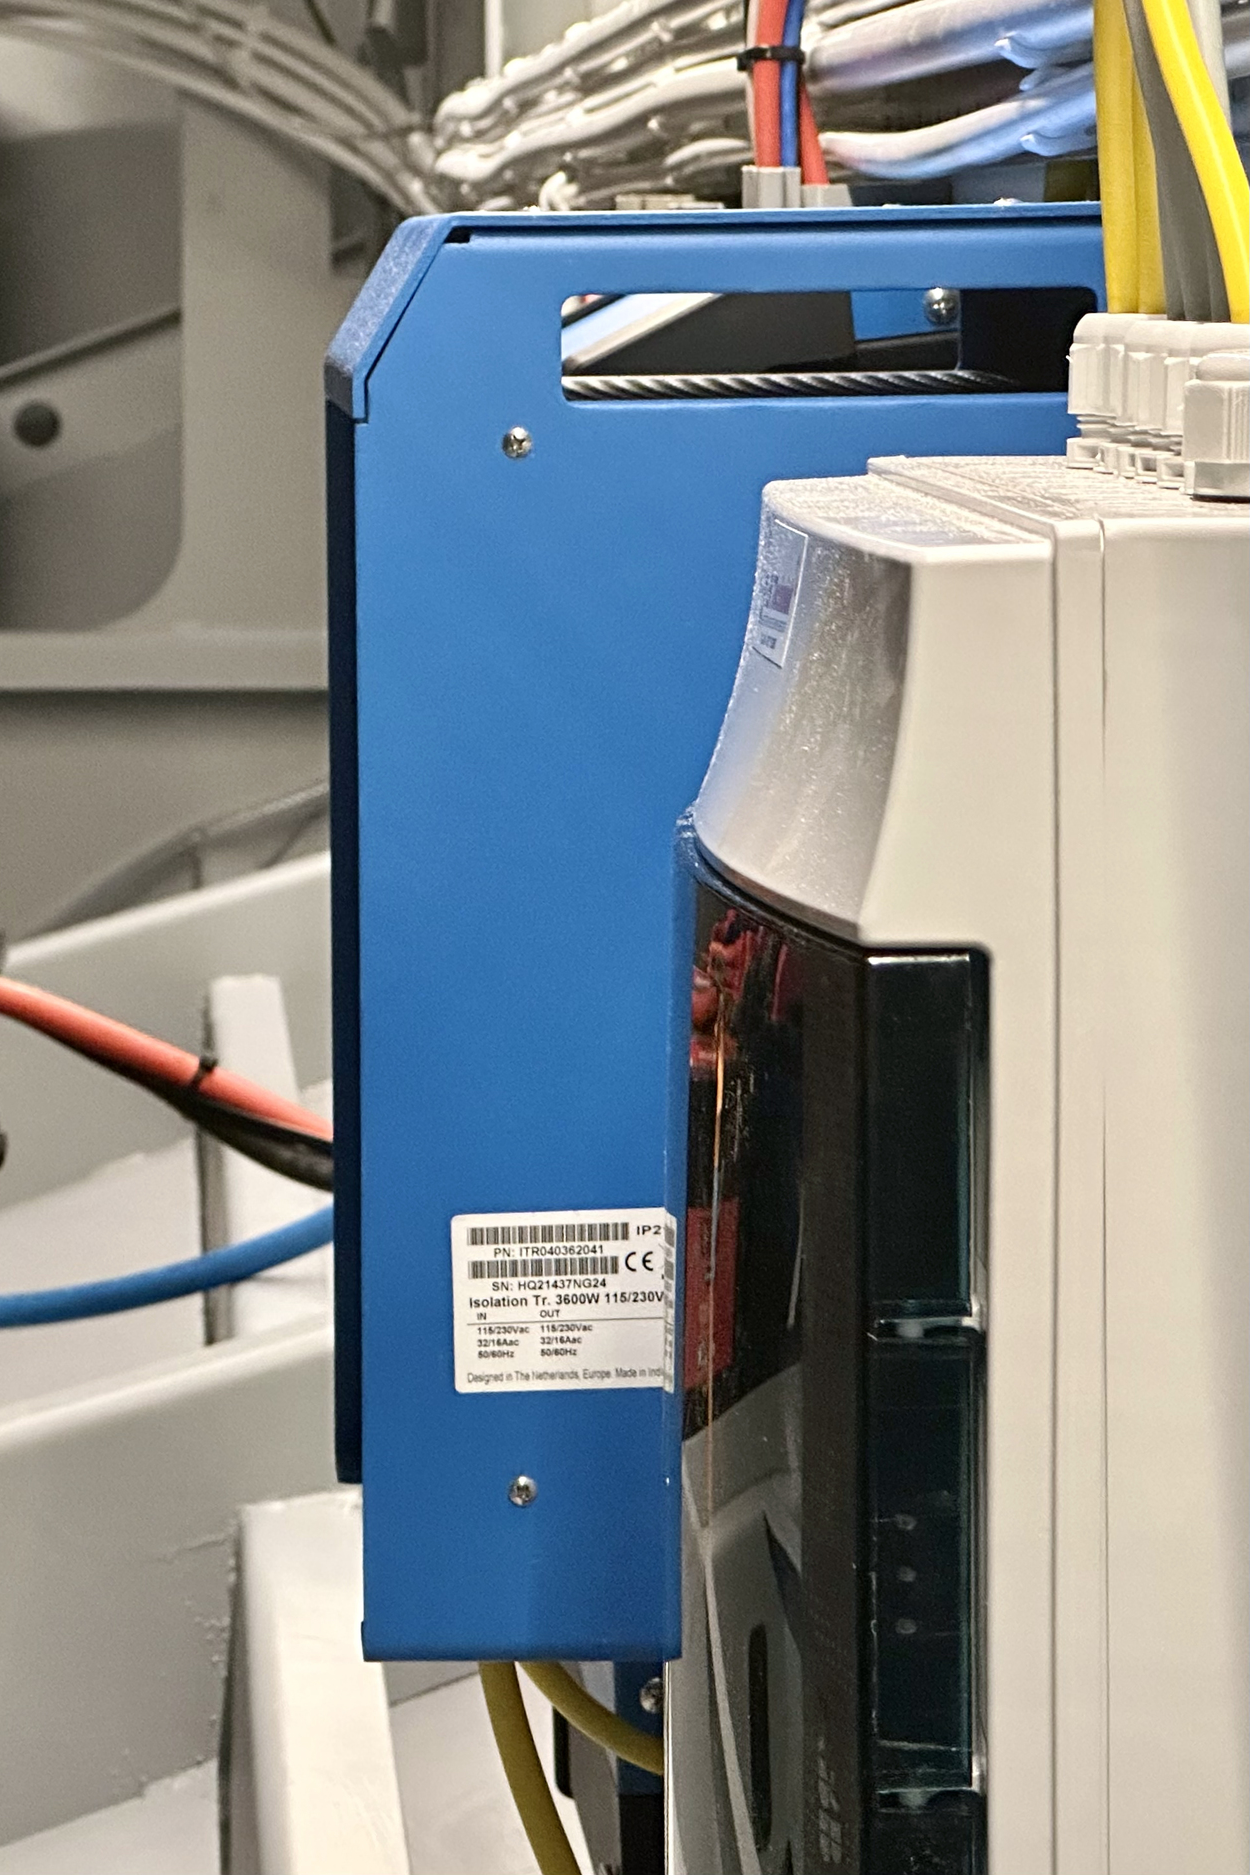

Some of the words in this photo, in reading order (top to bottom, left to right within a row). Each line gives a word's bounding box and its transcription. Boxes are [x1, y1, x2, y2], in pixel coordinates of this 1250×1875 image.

[636, 1224, 662, 1236] IP2
[493, 1247, 515, 1258] PN:
[519, 1245, 604, 1257] ITR040362041
[491, 1281, 513, 1292] SN:
[518, 1278, 607, 1291] HQ21437NG24
[469, 1296, 528, 1309] Isolation
[532, 1294, 551, 1306] Tr.
[555, 1292, 600, 1305] 3600W
[476, 1312, 487, 1321] IN
[539, 1309, 561, 1318] OUT
[477, 1325, 530, 1335] 115/230Vac
[540, 1323, 593, 1333] 115/230Vac
[467, 1372, 503, 1385] Designed
[514, 1370, 530, 1381] The
[615, 1367, 637, 1378] Made
[639, 1367, 647, 1377] in
